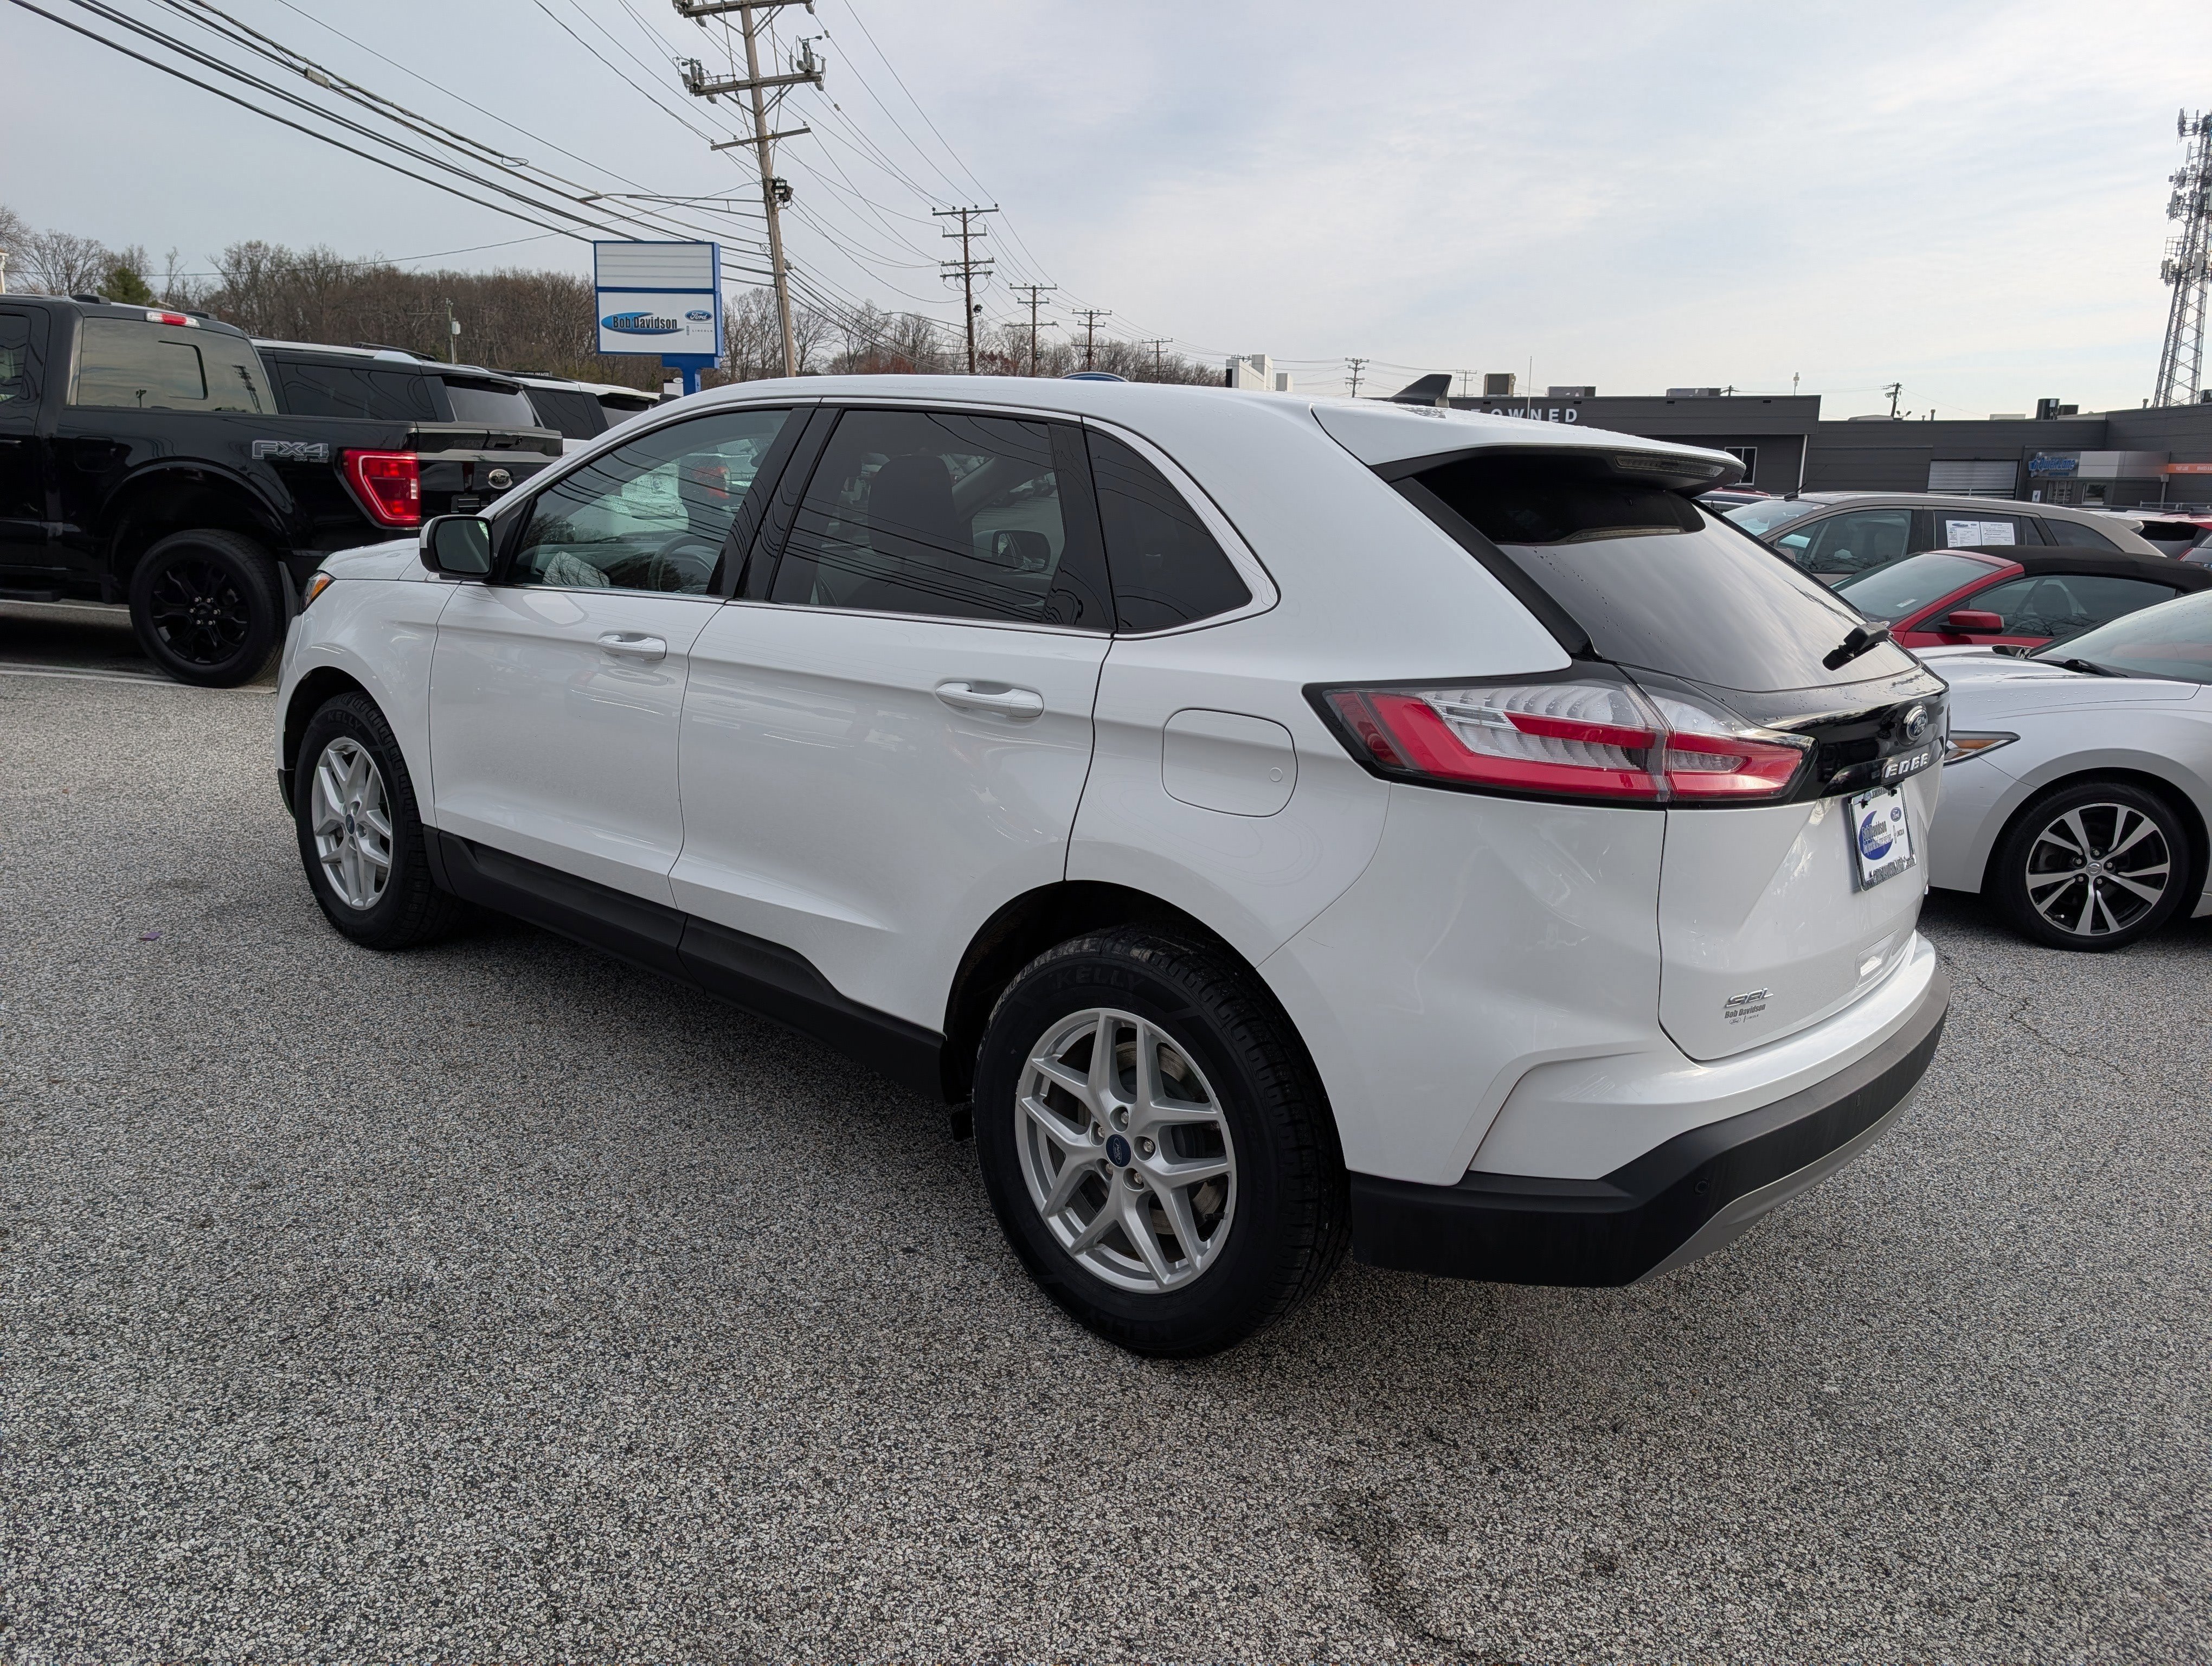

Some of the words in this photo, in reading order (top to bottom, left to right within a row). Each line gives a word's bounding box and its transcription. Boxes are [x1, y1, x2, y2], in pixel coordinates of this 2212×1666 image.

[613, 316, 631, 329] Bob
[633, 316, 678, 330] Davidson
[689, 311, 709, 321] Ford
[252, 439, 329, 460] FX4
[327, 710, 362, 731] KELLY
[1885, 753, 1928, 778] EDGE
[1056, 965, 1145, 992] KELLY
[1725, 988, 1774, 1008] SEL
[1724, 1009, 1738, 1019] Bob
[1738, 1004, 1766, 1016] Davidson
